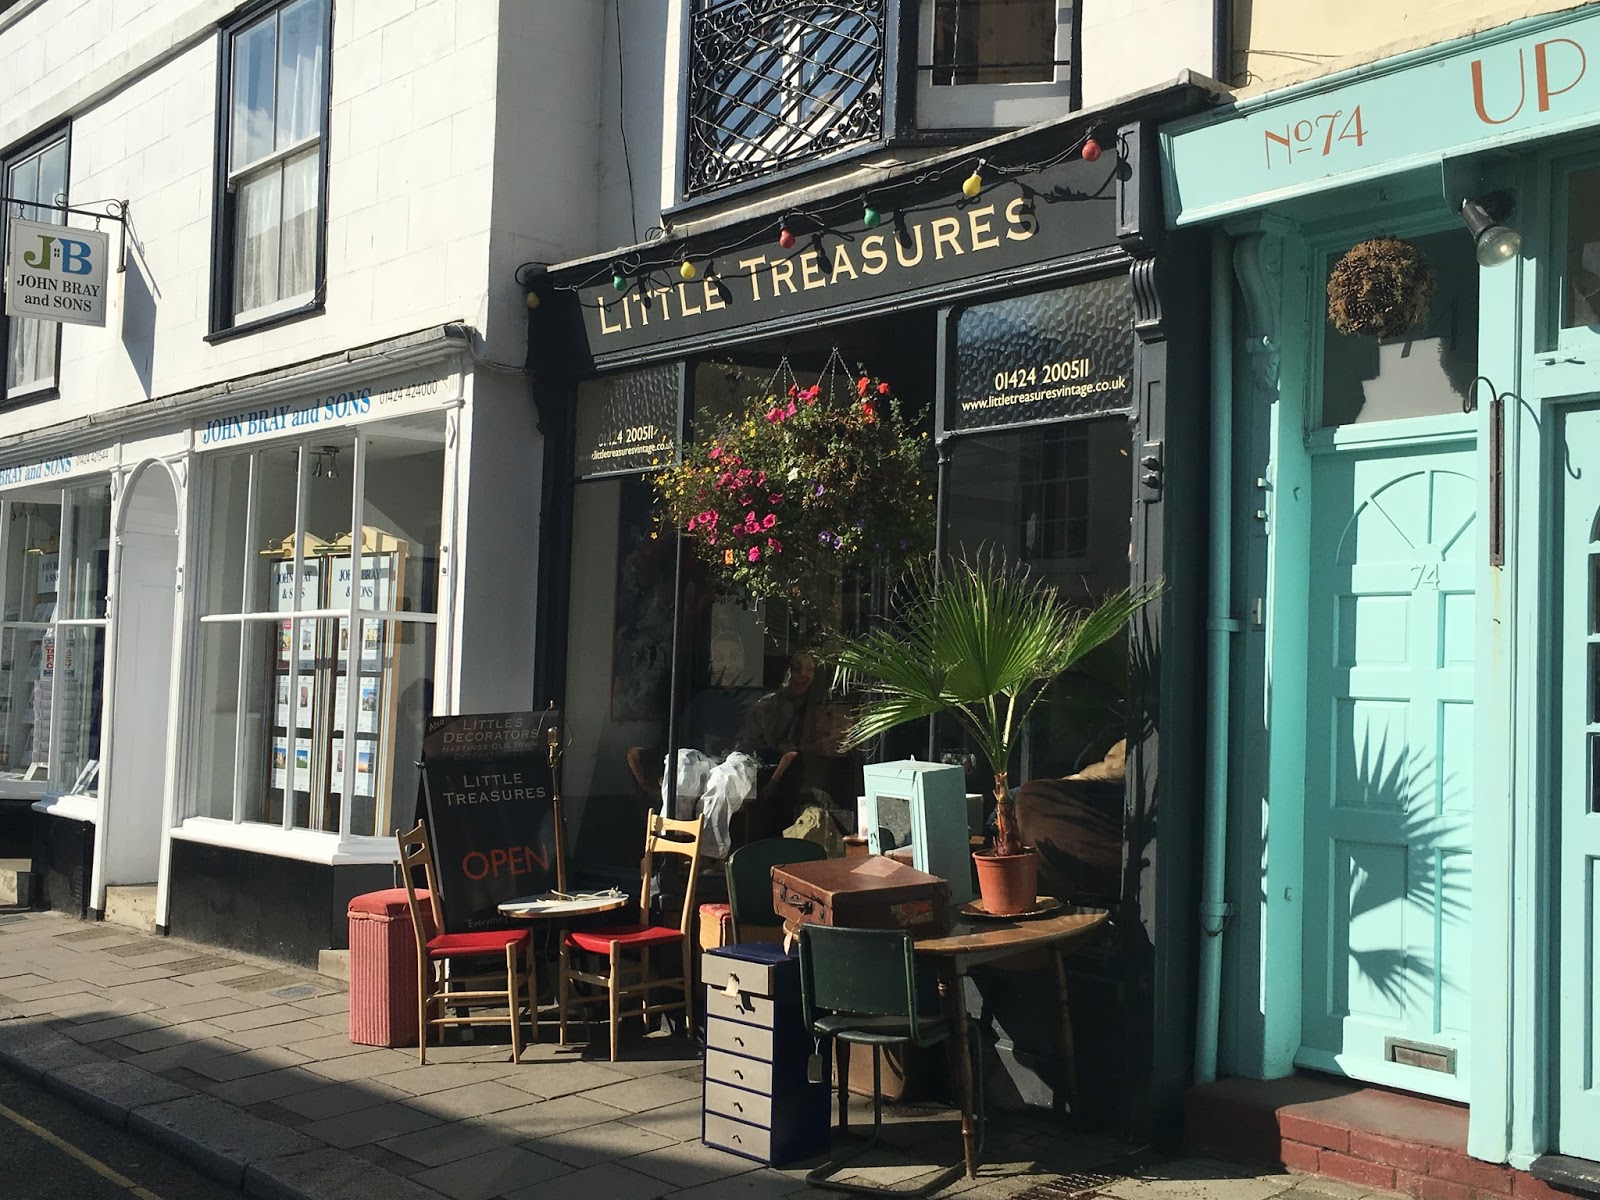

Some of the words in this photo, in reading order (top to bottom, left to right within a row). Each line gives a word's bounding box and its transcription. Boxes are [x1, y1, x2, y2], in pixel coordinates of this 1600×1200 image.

[1471, 38, 1586, 125] UP
[597, 273, 728, 336] LITTLE
[739, 197, 1037, 302] TREASURES
[17, 274, 58, 291] JOHN
[62, 280, 101, 298] BRAY
[24, 294, 50, 307] and
[53, 295, 92, 313] SONS
[994, 367, 1037, 391] 01424
[1042, 358, 1090, 385] 200511
[961, 376, 1127, 412] www.littletreasuresvintage.co.uk
[202, 414, 245, 445] JOHN
[247, 405, 291, 436] BRAY
[292, 399, 321, 427] and
[325, 387, 372, 420] SONS
[379, 387, 403, 405] 01424
[405, 379, 438, 399] 424000
[0, 463, 25, 486] BRAY
[25, 459, 43, 481] and
[44, 452, 73, 477] SONS
[1410, 563, 1440, 591] 74
[443, 728, 539, 744] DECORATORS
[443, 786, 546, 806] TREASURES
[463, 773, 523, 788] LITTLE
[462, 843, 550, 880] OPEN
